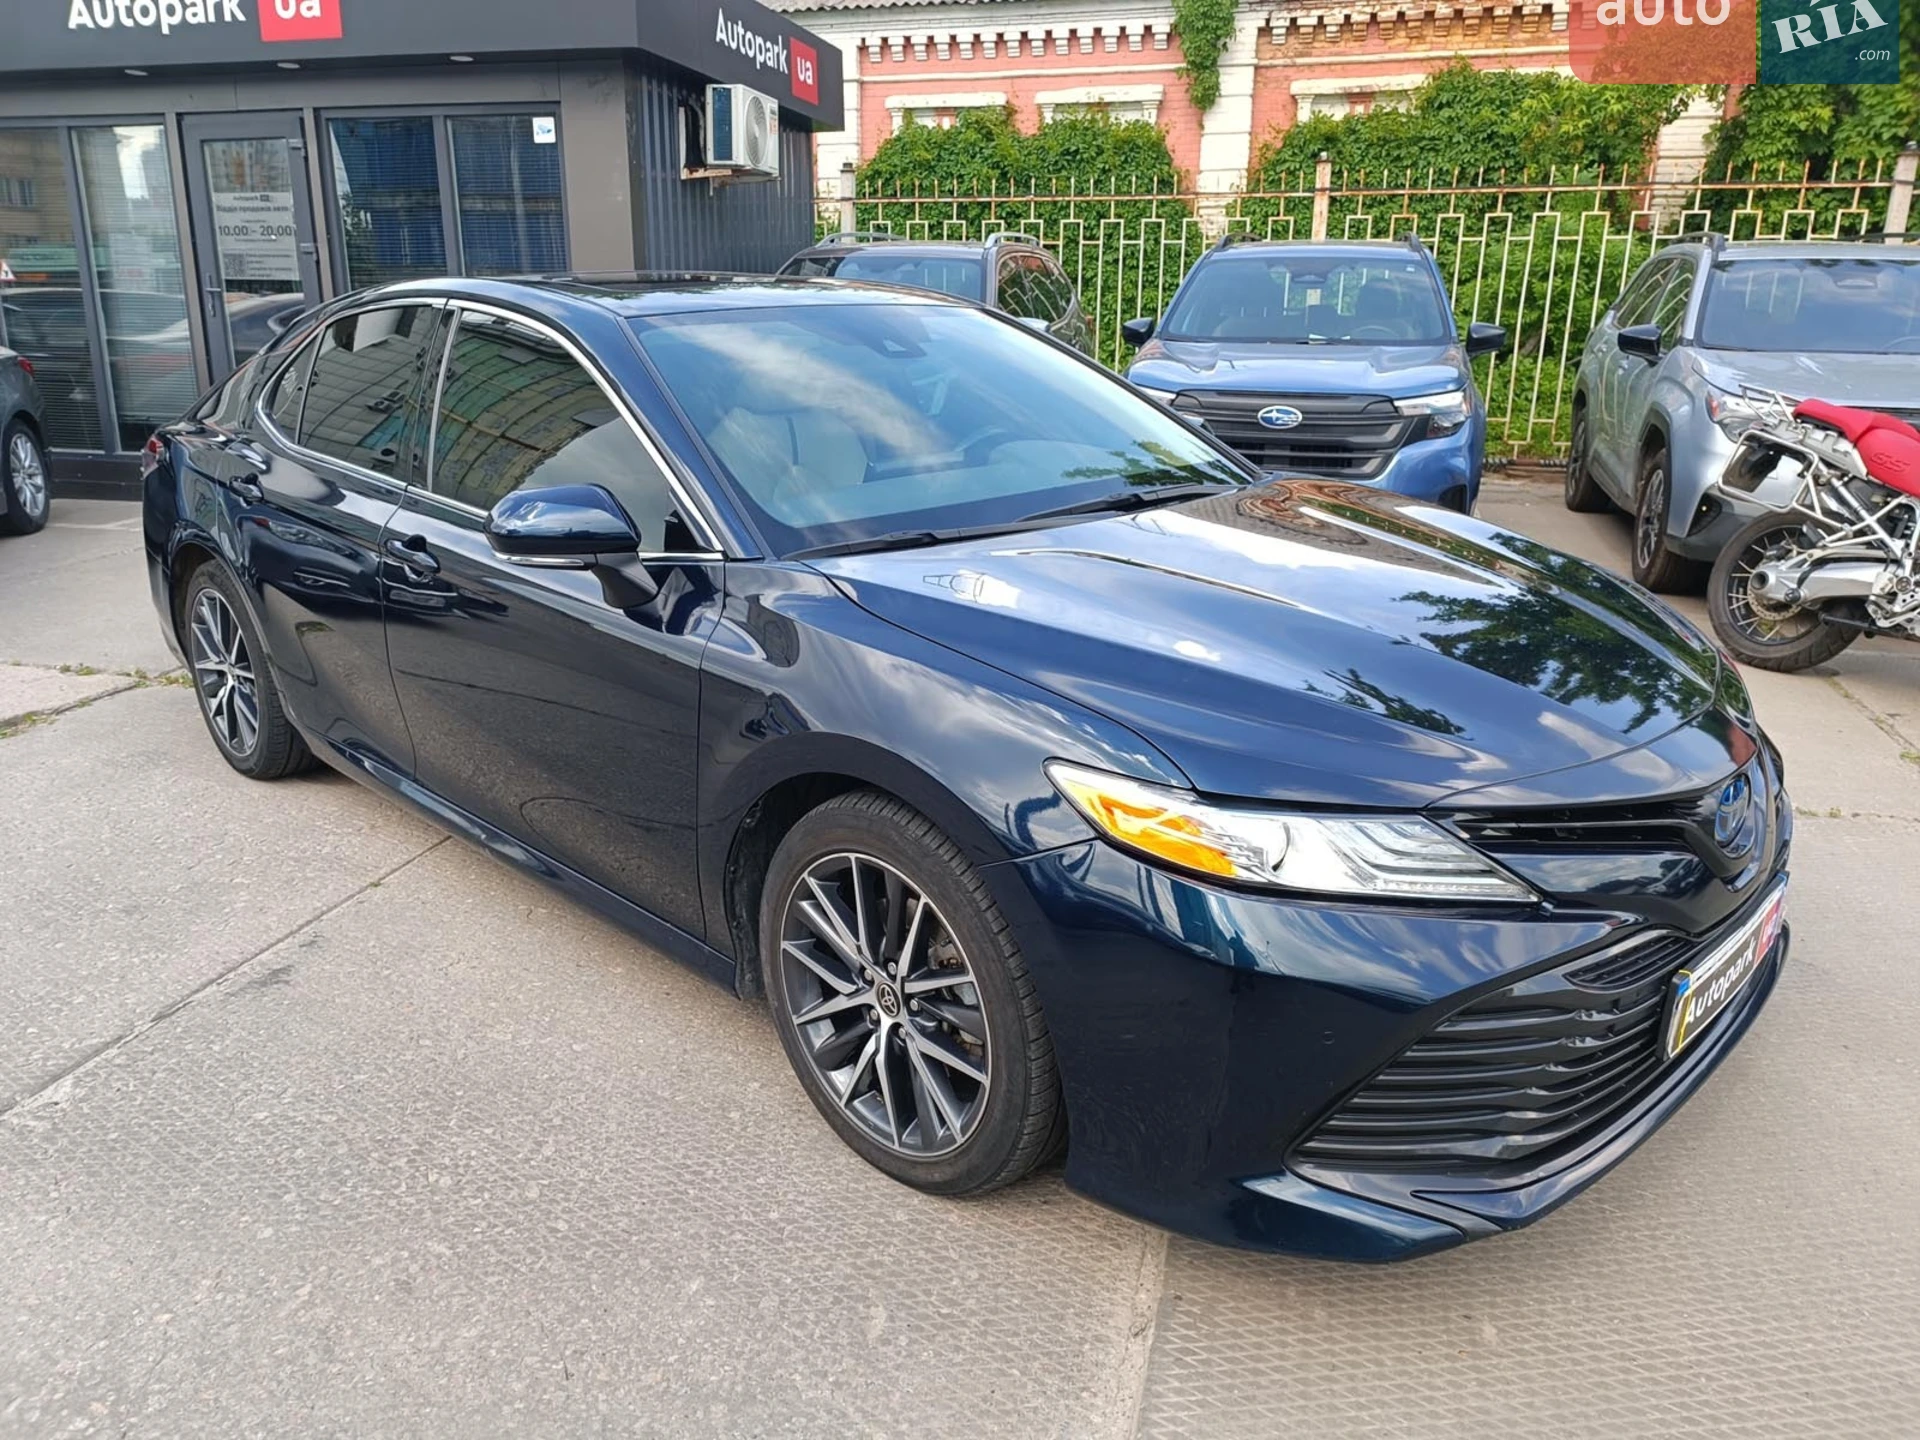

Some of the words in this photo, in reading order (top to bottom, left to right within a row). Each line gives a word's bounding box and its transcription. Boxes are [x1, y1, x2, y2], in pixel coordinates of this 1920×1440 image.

[68, 0, 247, 35] Autopark
[274, 0, 322, 19] ua
[715, 7, 789, 75] Autopark
[797, 56, 814, 86] ua
[218, 225, 249, 236] 10.00
[259, 225, 292, 237] 20.00
[1685, 936, 1757, 1024] Autopark
